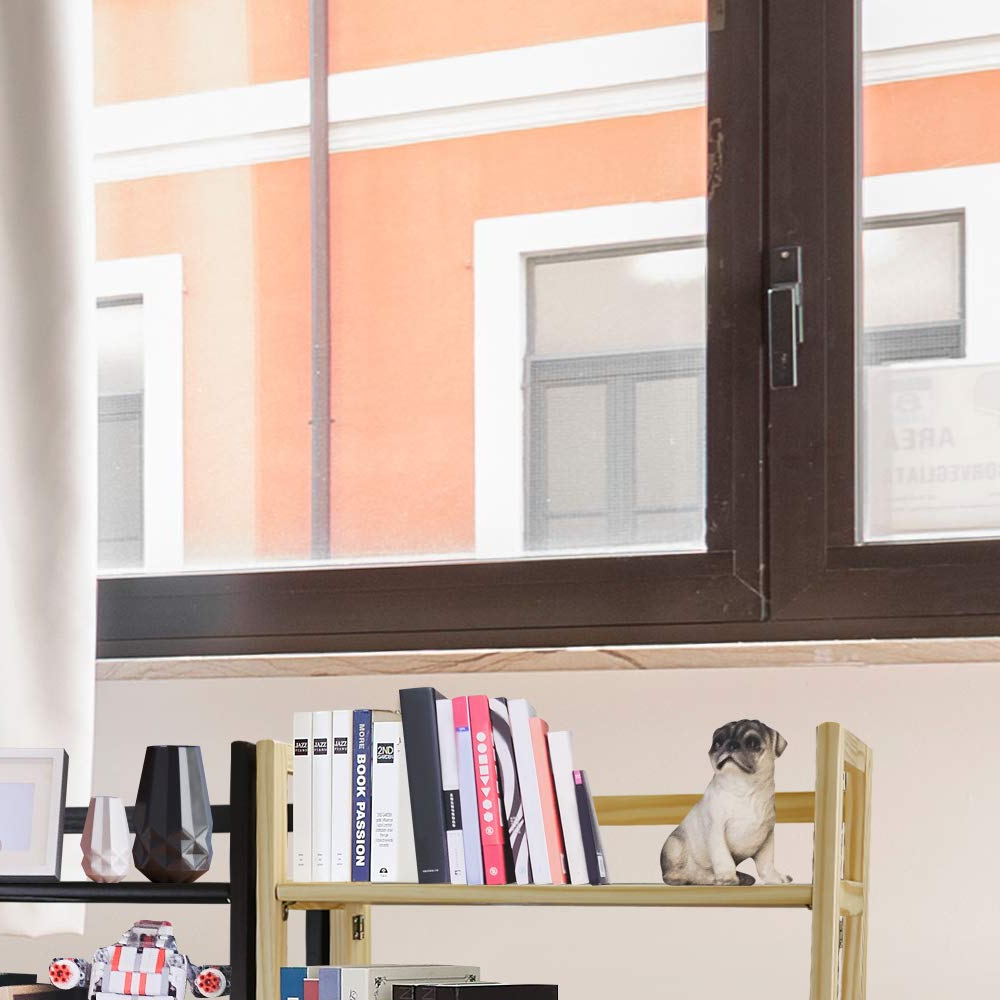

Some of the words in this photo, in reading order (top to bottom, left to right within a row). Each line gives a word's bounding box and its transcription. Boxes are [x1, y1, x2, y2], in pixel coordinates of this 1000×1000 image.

[377, 746, 394, 755] 2ND
[356, 754, 367, 798] BOOK
[355, 801, 366, 867] PASSION
